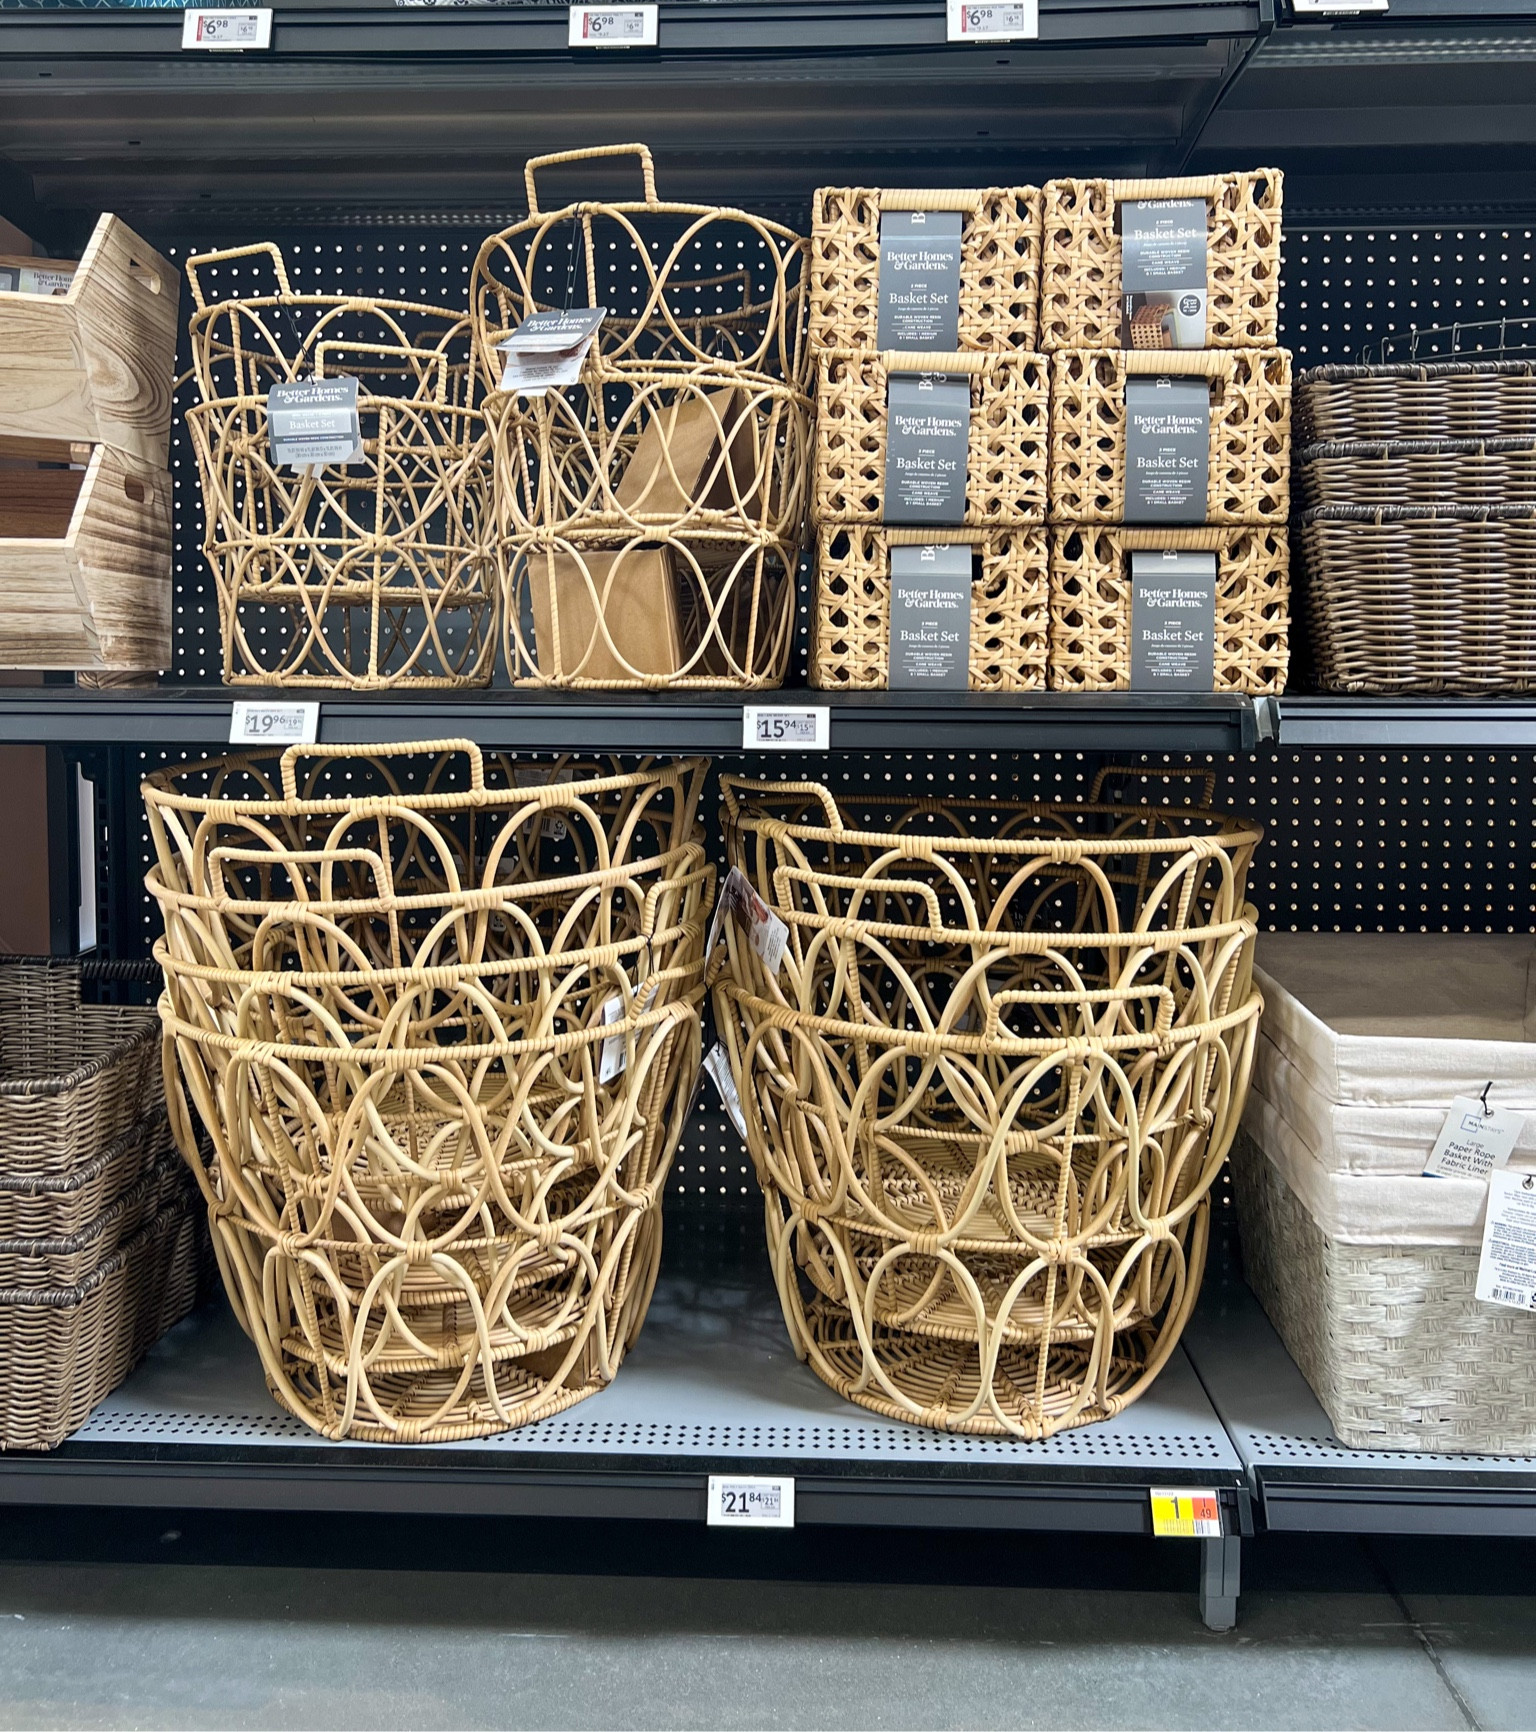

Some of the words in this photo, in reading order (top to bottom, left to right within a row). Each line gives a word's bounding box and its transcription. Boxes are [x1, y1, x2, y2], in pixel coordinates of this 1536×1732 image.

[1134, 228, 1175, 240] Basket
[1177, 228, 1196, 238] Set
[888, 251, 917, 262] Better
[919, 251, 953, 261] Homes
[34, 272, 55, 280] Better
[889, 292, 927, 304] Basket
[930, 293, 948, 304] Set
[527, 320, 558, 328] Better
[277, 388, 310, 397] Better
[312, 386, 348, 394] Homes
[290, 419, 320, 429] Basket
[321, 419, 335, 428] Set
[895, 415, 926, 427] Better
[927, 416, 962, 428] Homes
[1134, 415, 1166, 425] Better
[1167, 415, 1202, 424] Homes
[896, 457, 935, 469] Basket
[938, 459, 956, 470] Set
[1137, 456, 1176, 468] Basket
[1179, 457, 1199, 468] Set
[898, 589, 928, 599] Better
[930, 590, 964, 600] Homes
[1140, 588, 1171, 598] Better
[1172, 589, 1208, 598] Homes
[900, 629, 938, 641] Basket
[941, 631, 959, 642] Set
[1142, 629, 1182, 640] Basket
[1185, 630, 1204, 641] Set
[1467, 1139, 1484, 1148] Large
[1449, 1142, 1473, 1154] Paper
[1474, 1150, 1495, 1160] Rope
[1444, 1149, 1471, 1162] Basket
[1474, 1157, 1493, 1168] With
[1441, 1157, 1466, 1169] Fabric
[1468, 1164, 1488, 1175] Liner
[1171, 1496, 1179, 1519] 1
[1200, 1509, 1211, 1518] 49
